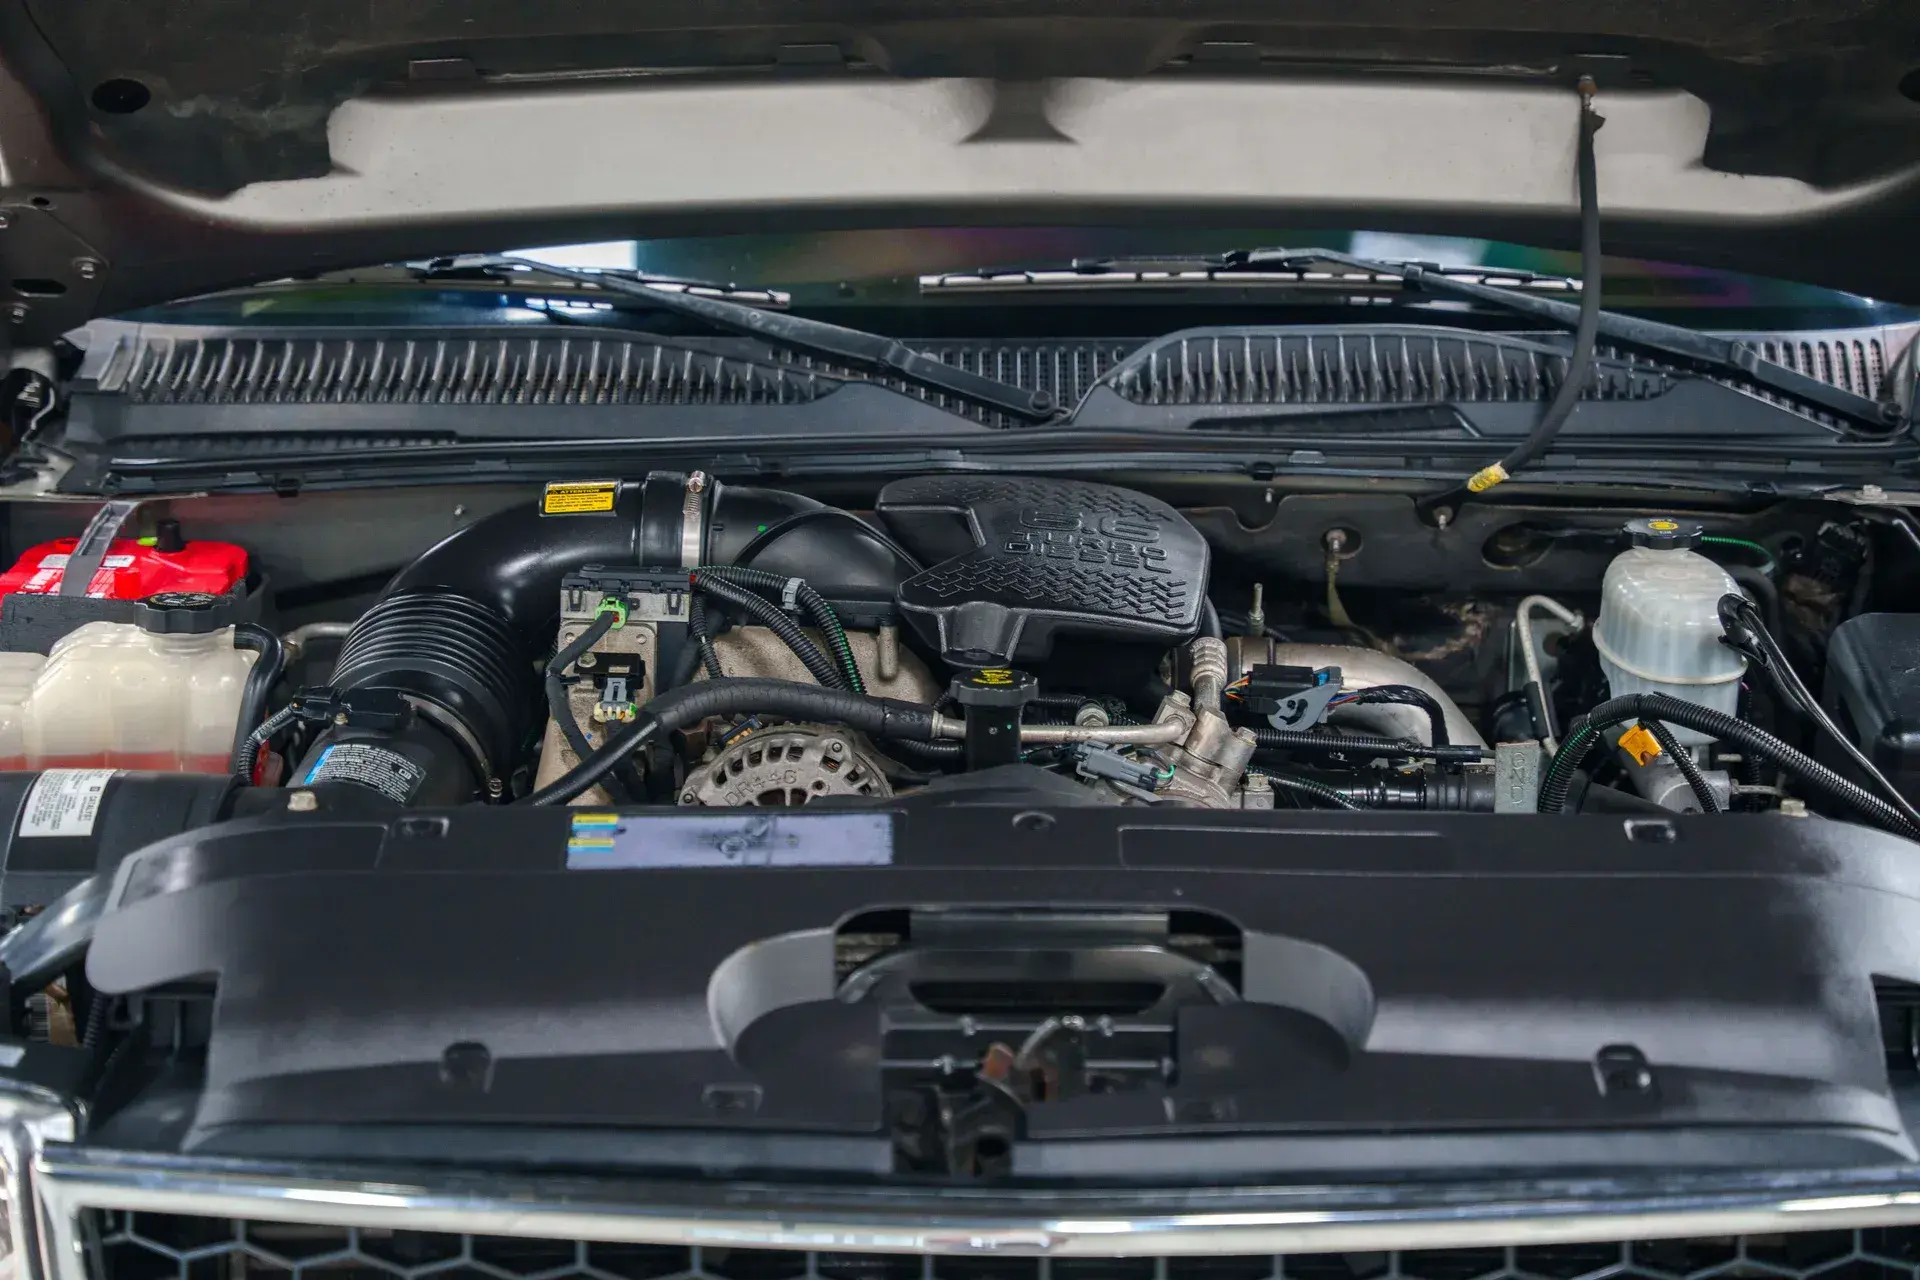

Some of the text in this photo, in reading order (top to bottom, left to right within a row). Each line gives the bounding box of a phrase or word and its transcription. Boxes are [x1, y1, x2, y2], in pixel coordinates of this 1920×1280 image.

[1018, 507, 1160, 543] 6.6
[1004, 541, 1172, 574] DIESEL
[1011, 530, 1168, 560] TURBO
